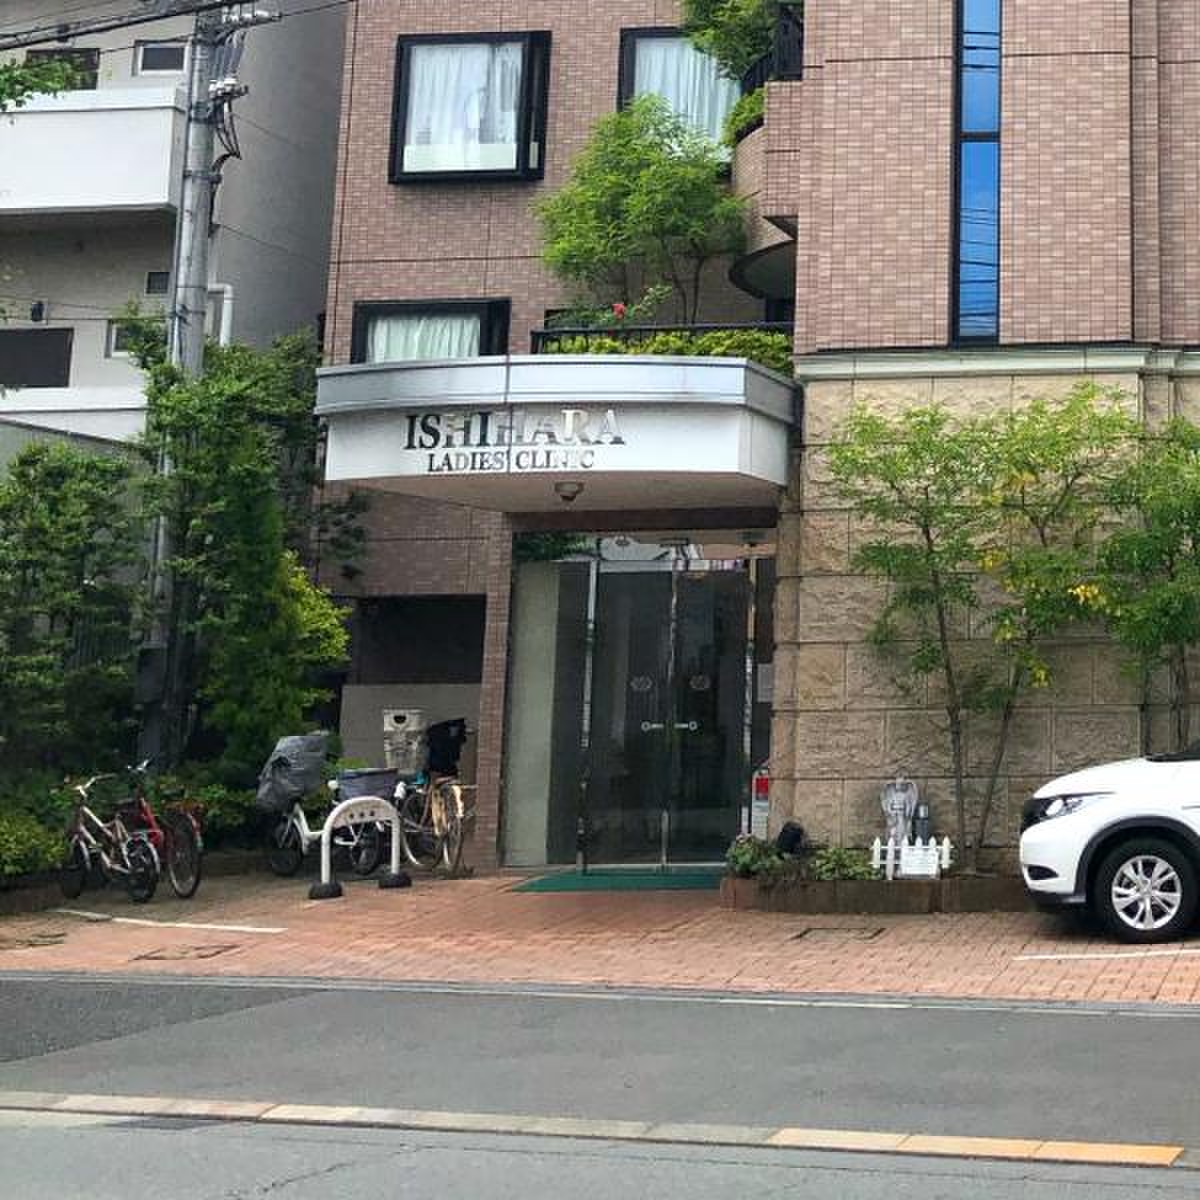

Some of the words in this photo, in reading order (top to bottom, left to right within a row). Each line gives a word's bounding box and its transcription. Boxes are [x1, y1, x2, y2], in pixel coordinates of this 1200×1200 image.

[403, 409, 625, 450] ISHIHARA
[428, 451, 506, 472] LADIES
[515, 450, 595, 470] CLINIC
